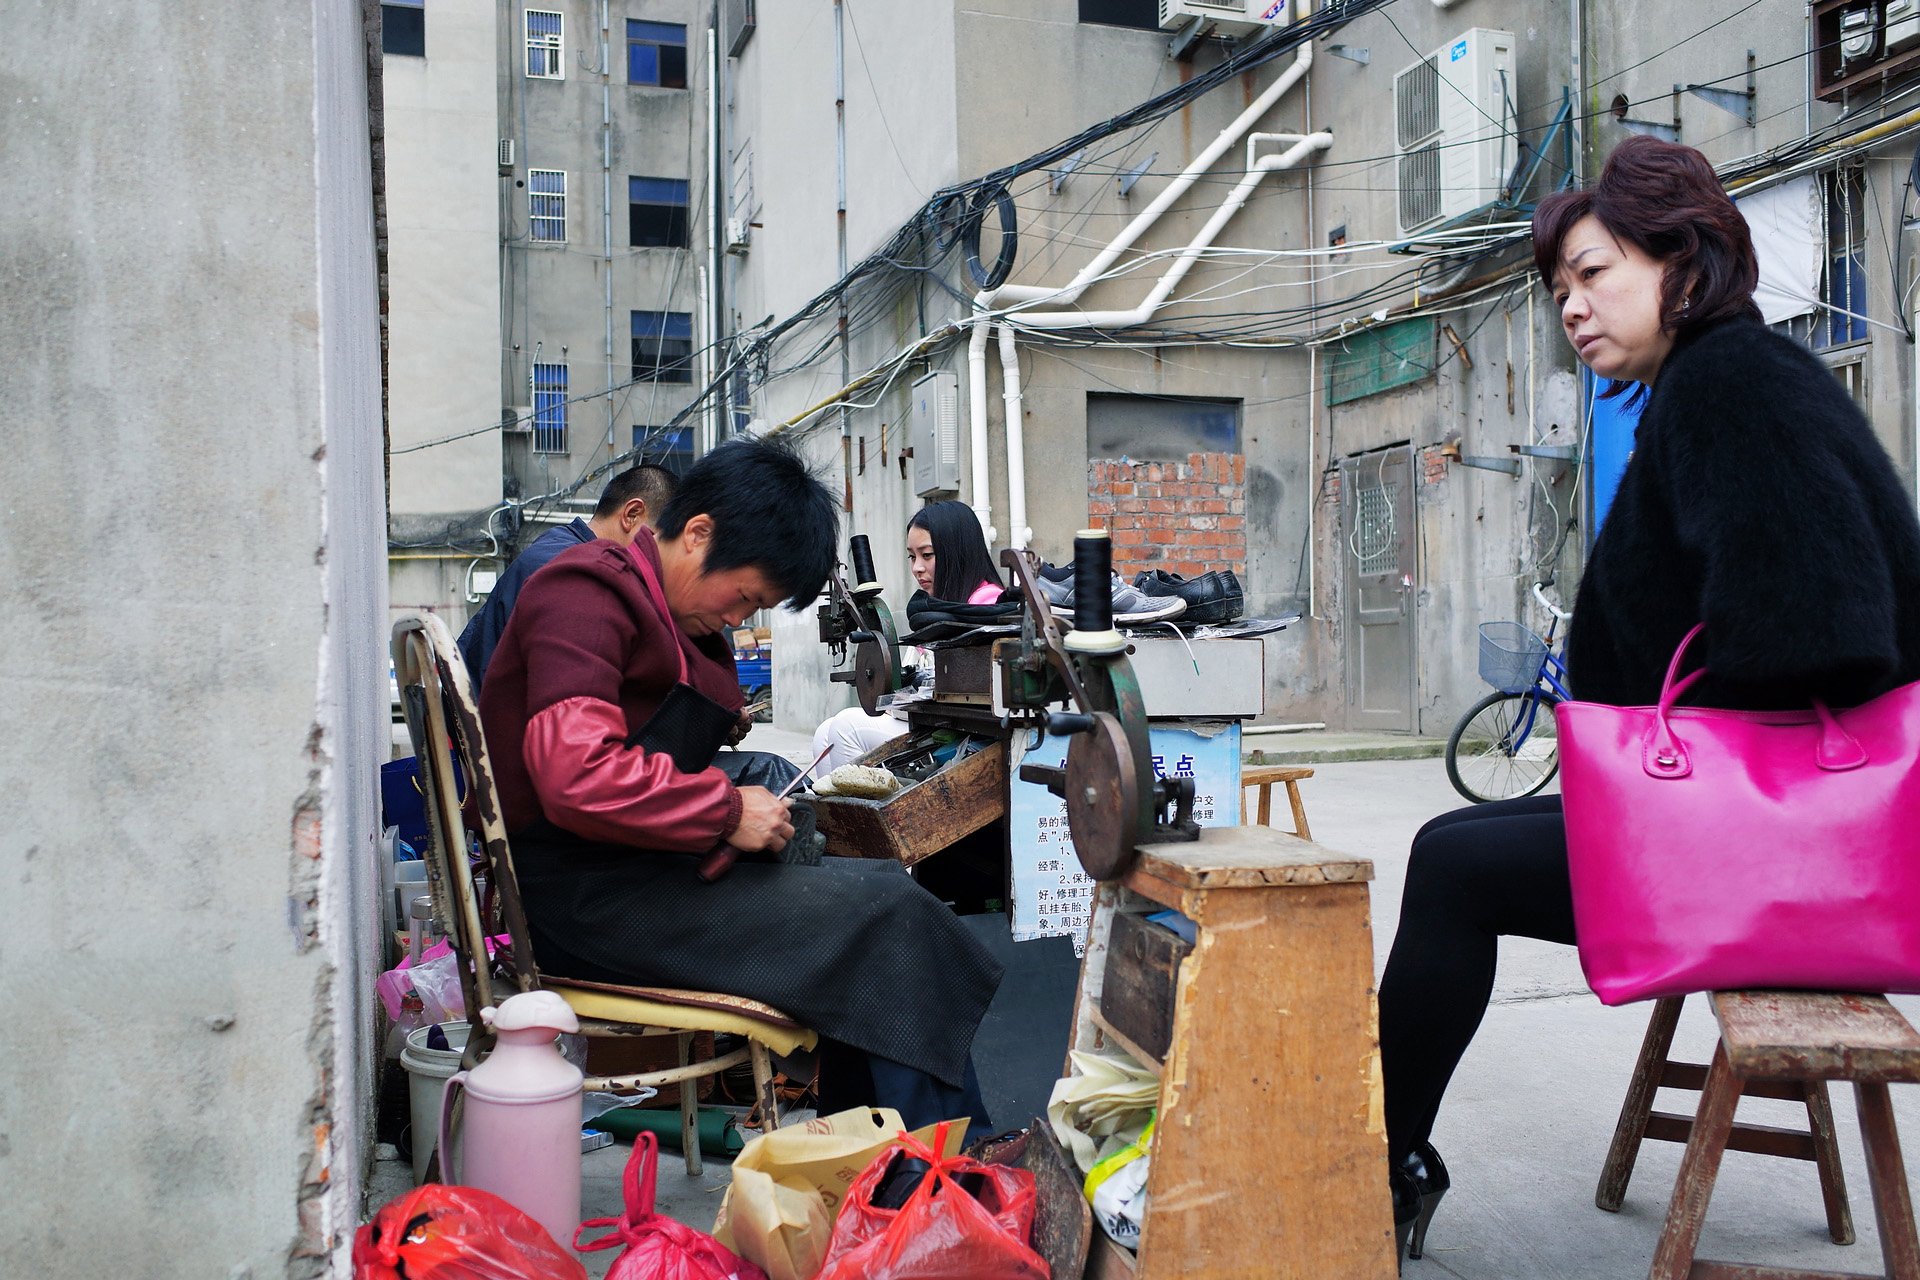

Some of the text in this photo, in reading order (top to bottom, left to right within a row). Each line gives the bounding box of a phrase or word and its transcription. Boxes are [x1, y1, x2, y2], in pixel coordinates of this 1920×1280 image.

[1192, 795, 1214, 807] 户交
[1193, 809, 1214, 821] 修理
[1076, 944, 1085, 955] 保
